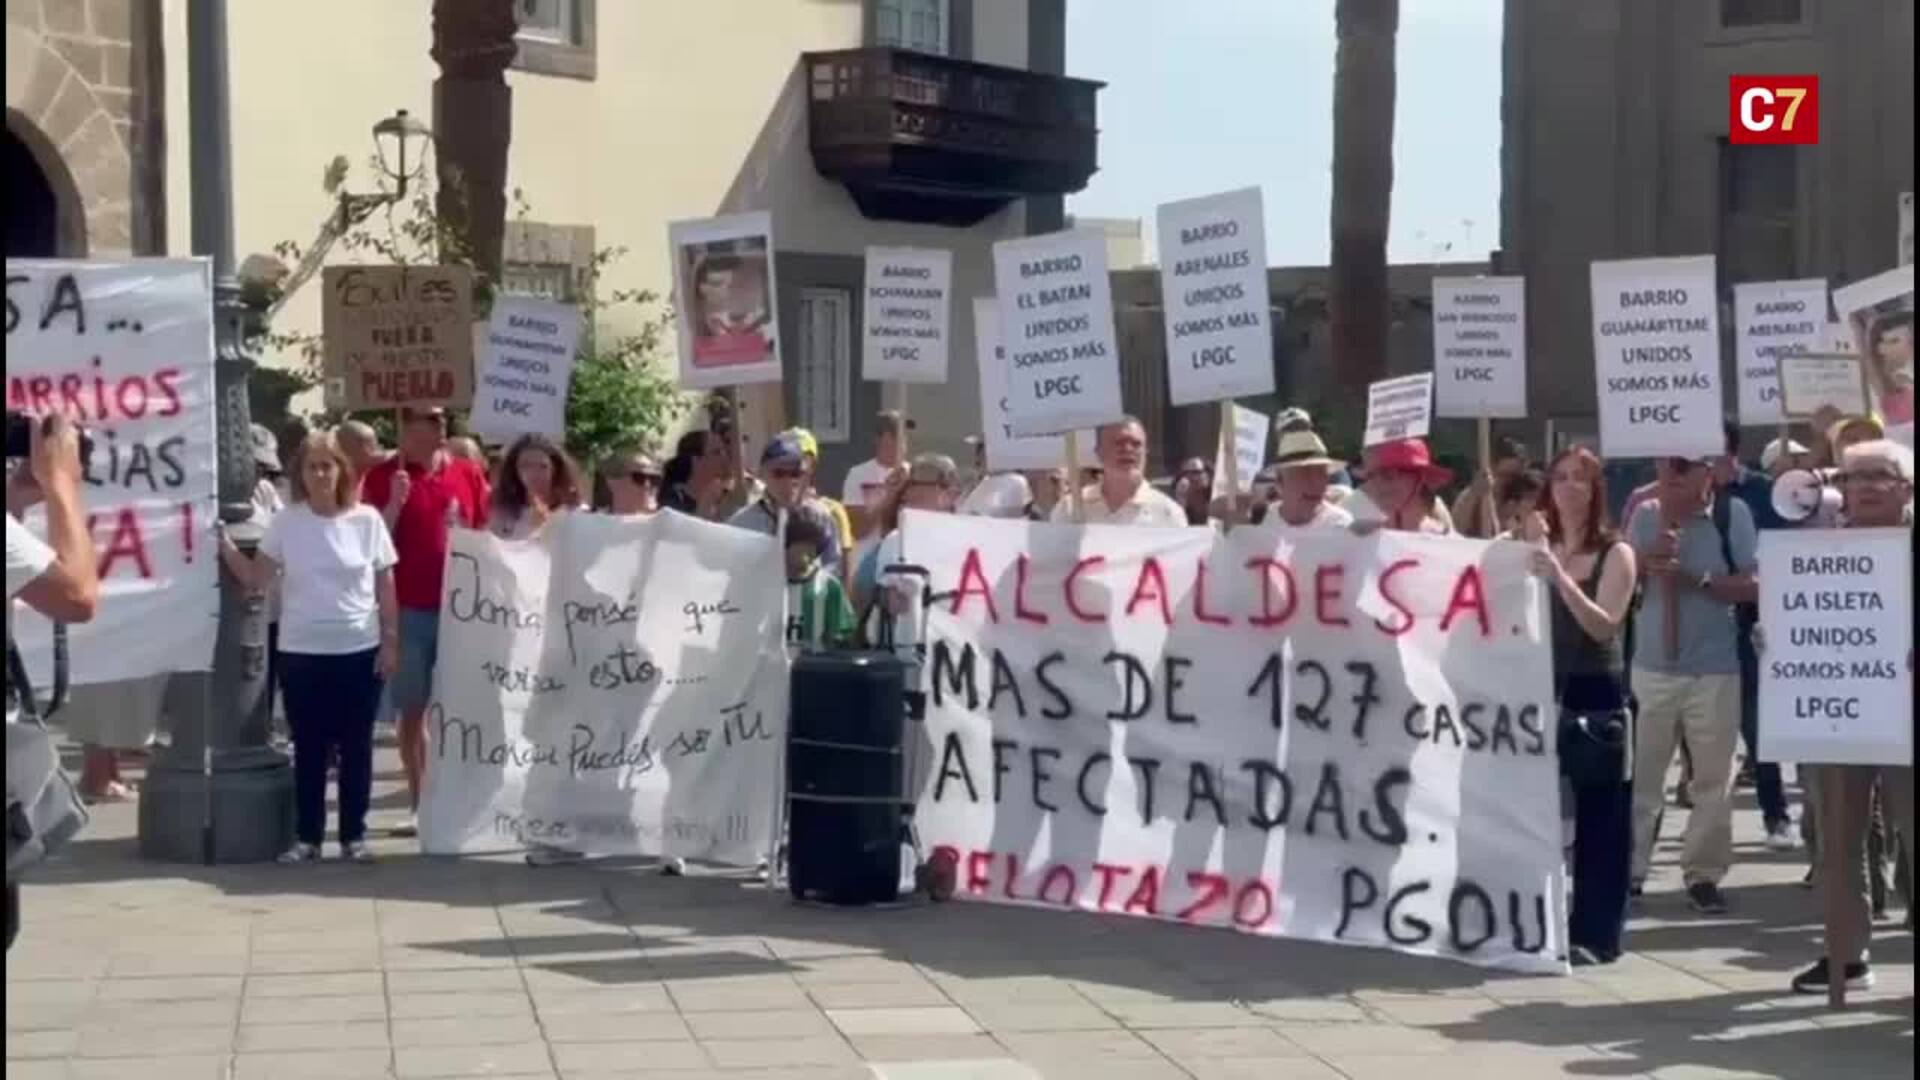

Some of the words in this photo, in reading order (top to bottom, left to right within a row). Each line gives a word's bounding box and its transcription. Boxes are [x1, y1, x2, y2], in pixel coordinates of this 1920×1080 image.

[1180, 220, 1239, 245] BARRIO
[1020, 253, 1082, 278] BARRIO
[1174, 249, 1249, 277] ARENALES
[1017, 293, 1036, 309] EL
[1184, 282, 1244, 307] UNIDOS
[1620, 289, 1688, 308] BARRIO
[1755, 300, 1806, 315] BARRIO
[1025, 313, 1089, 340] UNIDOS
[1173, 315, 1224, 338] SOMOS
[1013, 347, 1068, 369] SOMOS
[1191, 345, 1236, 370] LPGC
[1621, 344, 1693, 364] UNIDOS
[1454, 366, 1495, 382] LPGC
[1607, 375, 1669, 394] SOMOS
[1671, 371, 1711, 390] MÁS
[1034, 374, 1083, 400] LPGC
[1629, 403, 1682, 424] LPGC
[1791, 556, 1874, 576] BARRIO
[950, 547, 1523, 637] ALCALDESA.
[1782, 592, 1809, 611] LA
[1814, 591, 1884, 611] ISLETA
[683, 600, 741, 635] que
[1790, 627, 1877, 647] UNIDOS
[1771, 661, 1845, 680] SOMOS
[1850, 659, 1897, 680] MÁS
[931, 639, 1073, 720] MAS
[1103, 650, 1197, 724] DE
[1247, 658, 1381, 738] 127
[1403, 701, 1546, 757] CASAS
[1795, 697, 1861, 720] LPGC
[934, 732, 1439, 846] AFECTADAS.
